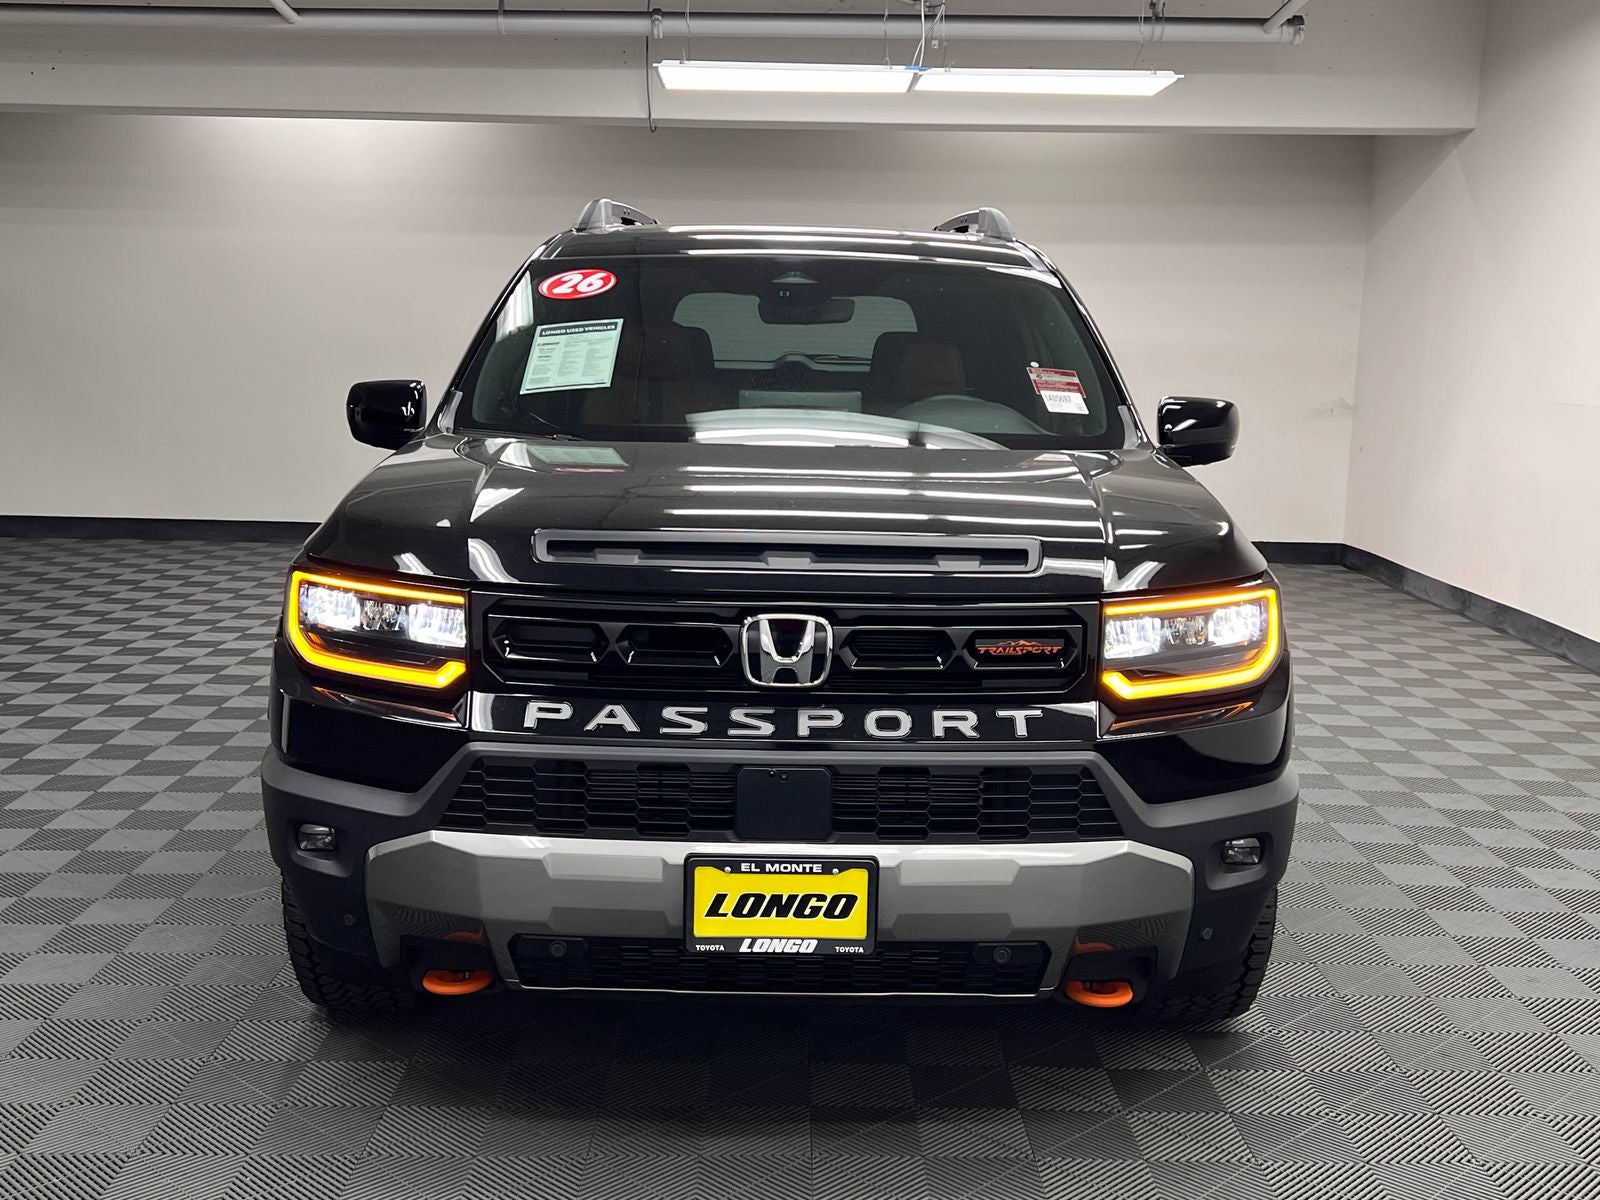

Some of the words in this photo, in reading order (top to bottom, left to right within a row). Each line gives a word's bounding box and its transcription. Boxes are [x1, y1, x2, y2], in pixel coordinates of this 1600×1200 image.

[552, 272, 607, 294] 26
[977, 646, 1063, 656] TRAILSPORT
[522, 700, 1044, 739] PASSPORT
[741, 863, 760, 873] EL
[765, 863, 823, 873] MONTE
[704, 893, 859, 919] LONGO
[695, 944, 725, 952] TOYOTA
[739, 939, 818, 953] LONGO
[835, 946, 864, 954] TOYOTA
